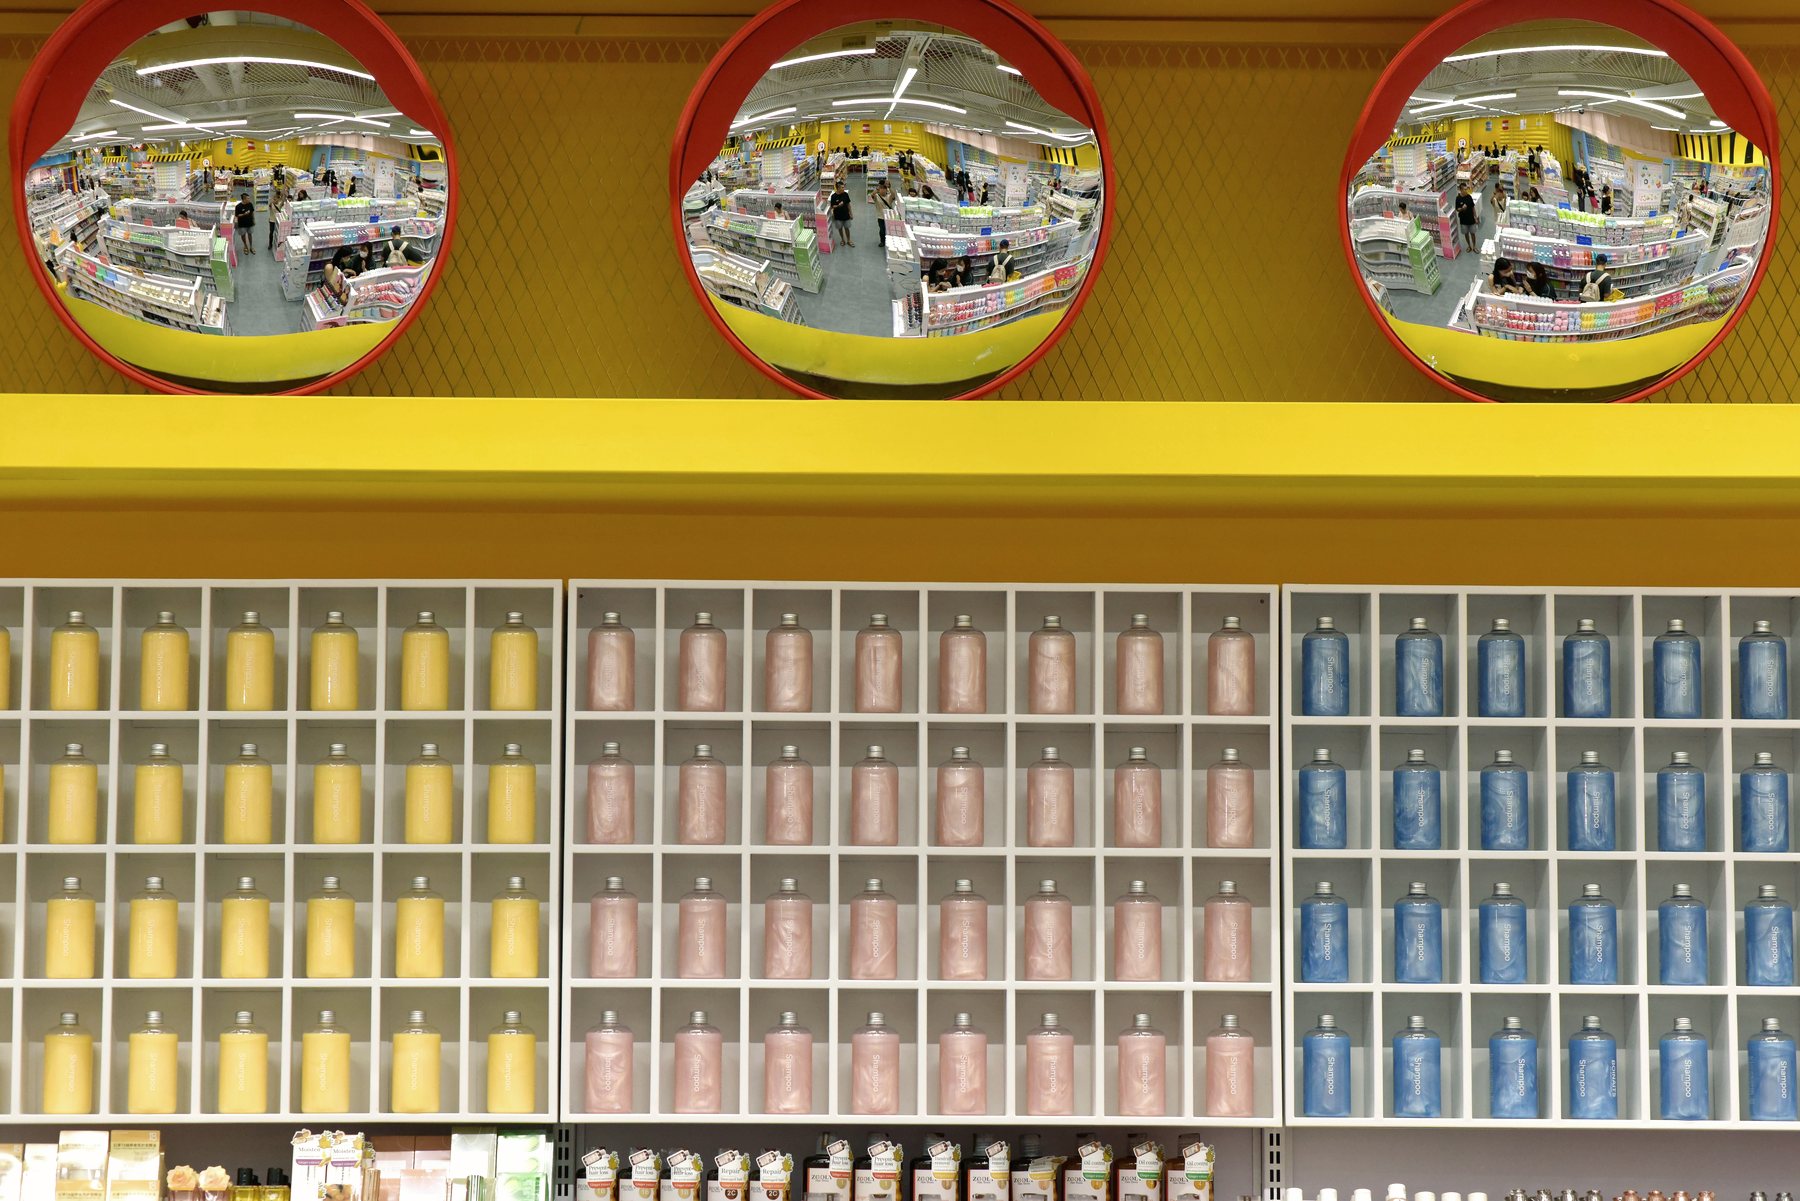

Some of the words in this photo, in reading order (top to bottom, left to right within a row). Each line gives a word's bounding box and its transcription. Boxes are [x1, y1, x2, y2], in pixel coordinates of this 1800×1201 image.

[1327, 656, 1335, 694] Shampoo
[1680, 658, 1688, 697] Shampoo
[1506, 790, 1514, 829] Shampoo
[1592, 792, 1600, 829] Shampoo
[698, 919, 706, 957] Shampoo
[786, 919, 794, 958] Shampoo
[962, 920, 970, 959] Shampoo
[1138, 921, 1146, 960] Shampoo
[1231, 921, 1239, 960] Shampoo
[1596, 924, 1604, 963] Shampoo
[1684, 925, 1692, 964] Shampoo
[1771, 926, 1779, 964] Shampoo
[873, 1054, 881, 1093] Shampoo
[960, 1055, 968, 1094] Shampoo
[1142, 1055, 1150, 1094] Shampoo
[1230, 1057, 1238, 1095] Shampoo
[1518, 1058, 1526, 1097] Shampoo
[1780, 1061, 1788, 1099] Shampoo
